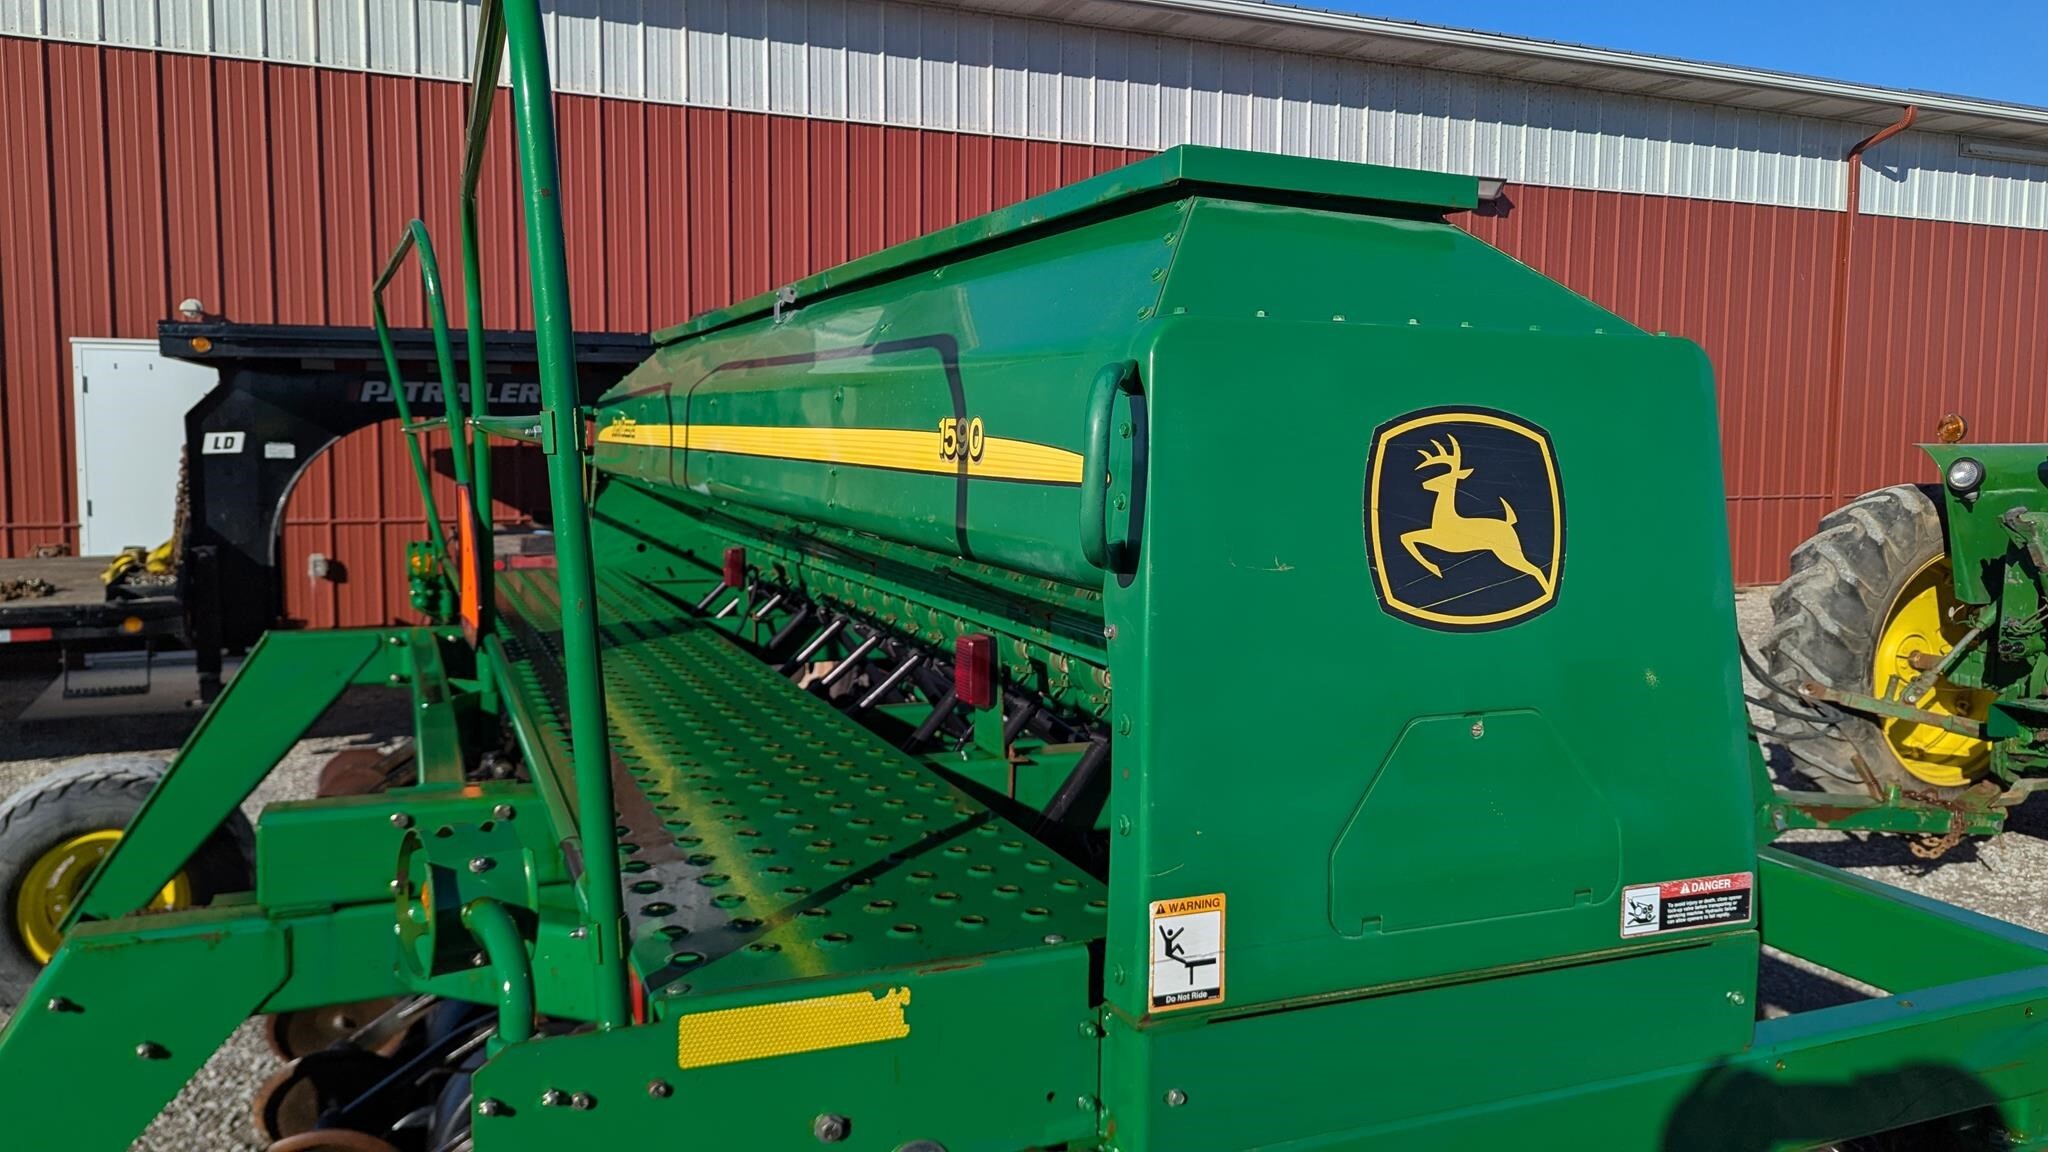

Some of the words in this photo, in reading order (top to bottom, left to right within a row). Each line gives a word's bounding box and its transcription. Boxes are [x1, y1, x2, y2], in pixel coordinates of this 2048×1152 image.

[213, 436, 235, 450] LD
[939, 416, 984, 460] 1590
[1691, 879, 1731, 892] DANGER
[1169, 898, 1220, 912] WARNING
[1708, 901, 1732, 909] transporting
[1165, 995, 1176, 1004] Do
[1177, 993, 1190, 1002] Not
[1191, 991, 1208, 999] Ride
